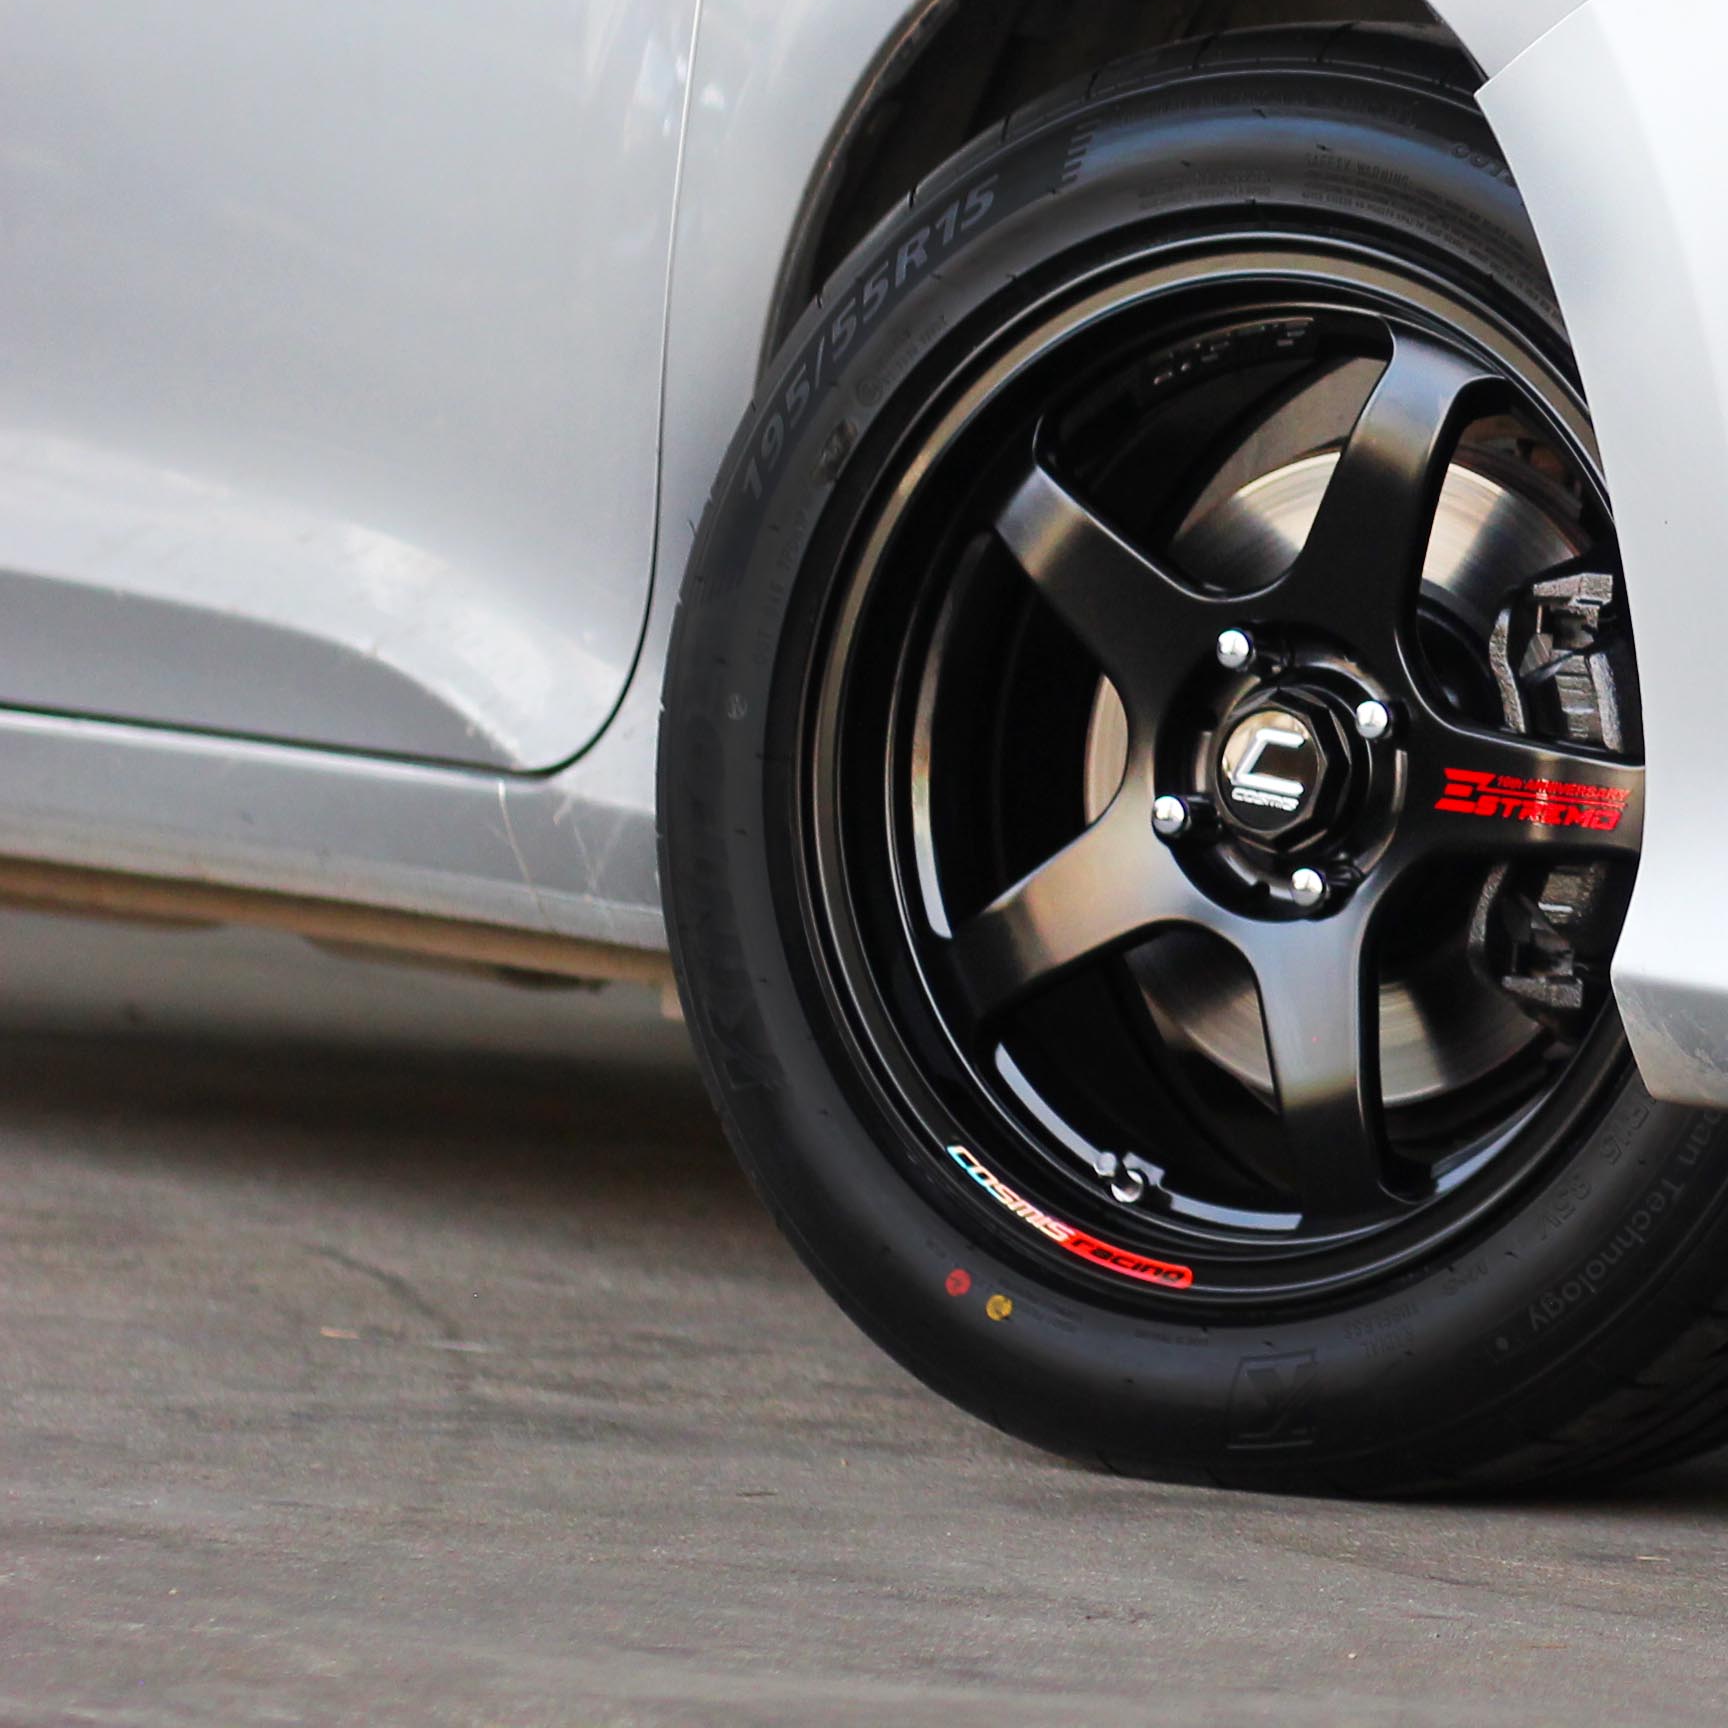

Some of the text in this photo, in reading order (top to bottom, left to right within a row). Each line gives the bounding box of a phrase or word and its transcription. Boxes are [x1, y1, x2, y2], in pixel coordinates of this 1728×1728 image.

[743, 173, 1000, 502] 195/55R15
[1071, 1238, 1186, 1284] racing
[1527, 1175, 1687, 1334] Technology
